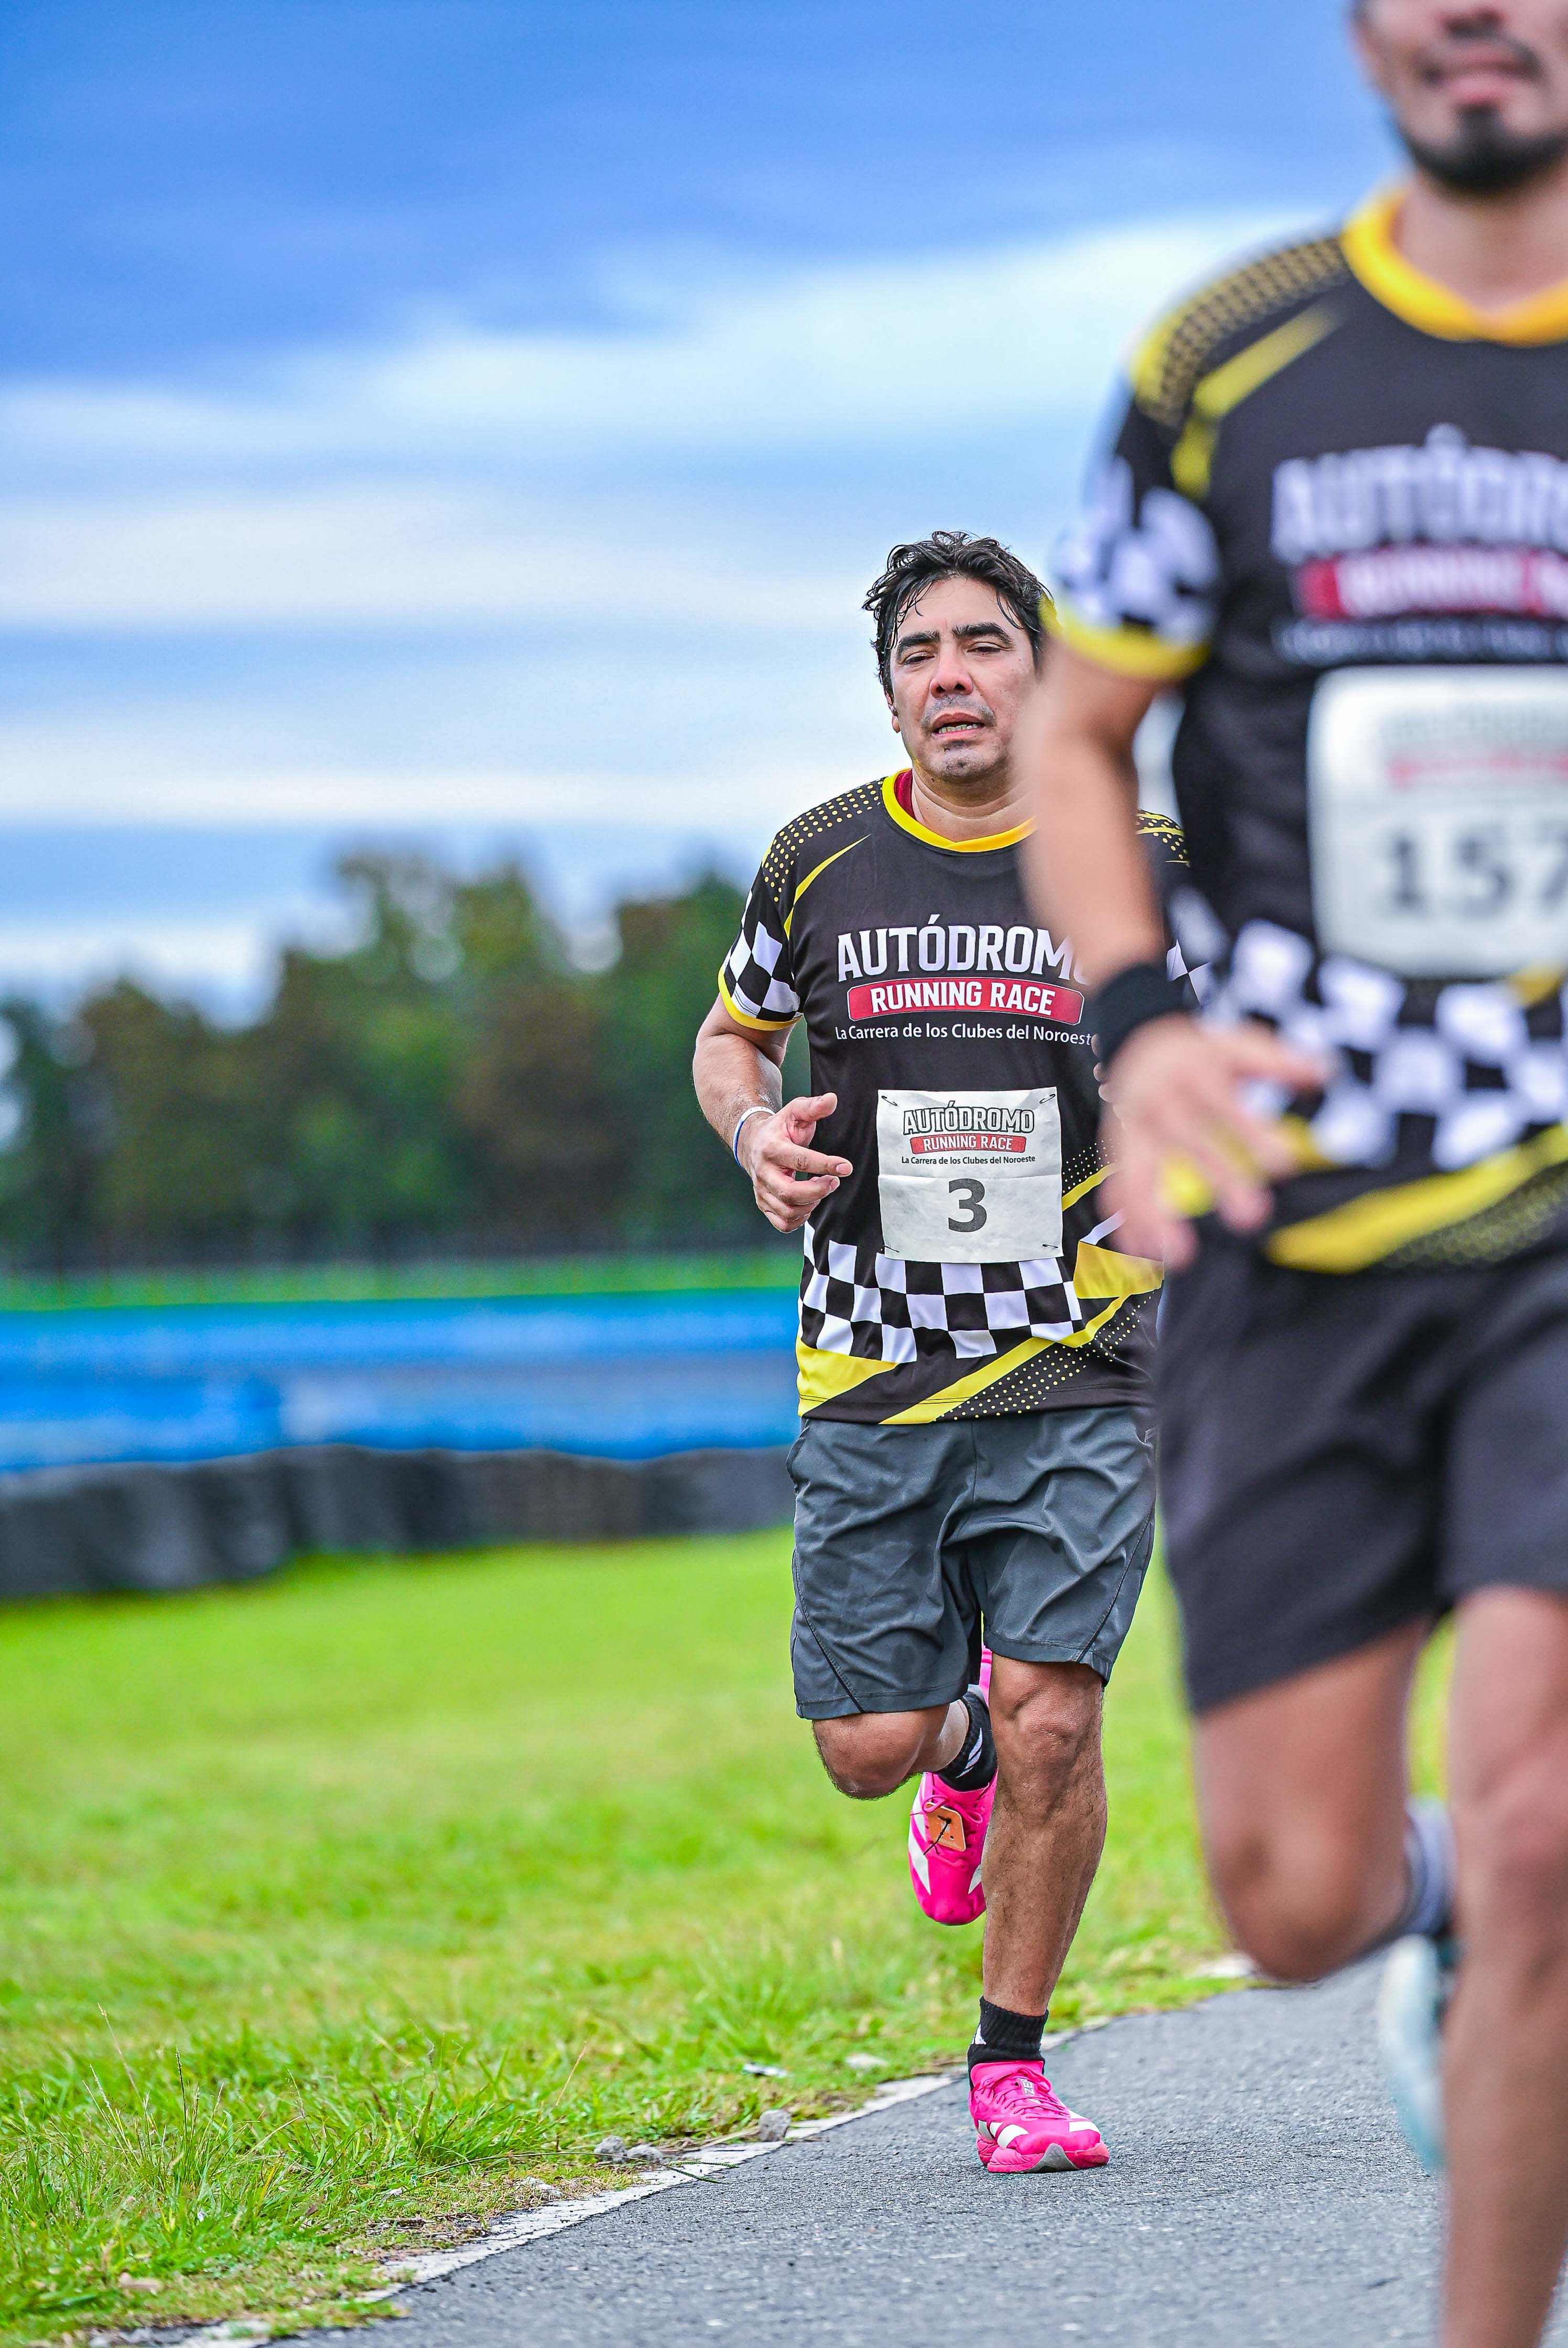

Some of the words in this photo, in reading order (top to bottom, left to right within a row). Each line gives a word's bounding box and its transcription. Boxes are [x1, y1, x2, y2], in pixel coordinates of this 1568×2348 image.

[870, 981, 982, 1014] RUNNING
[990, 982, 1056, 1016] RACE
[835, 1026, 847, 1040] La
[848, 1025, 899, 1039] Carrera
[903, 1022, 922, 1038] de
[926, 1022, 948, 1038] los
[951, 1023, 1003, 1038] Clubes
[1006, 1024, 1029, 1039] del
[1033, 1026, 1091, 1045] Noroest
[903, 1101, 1035, 1135] AUTÓDROMO
[923, 1135, 977, 1151] RUNNING
[980, 1136, 1013, 1150] RACE
[1003, 1155, 1036, 1164] Noroeste
[948, 1178, 987, 1232] 3
